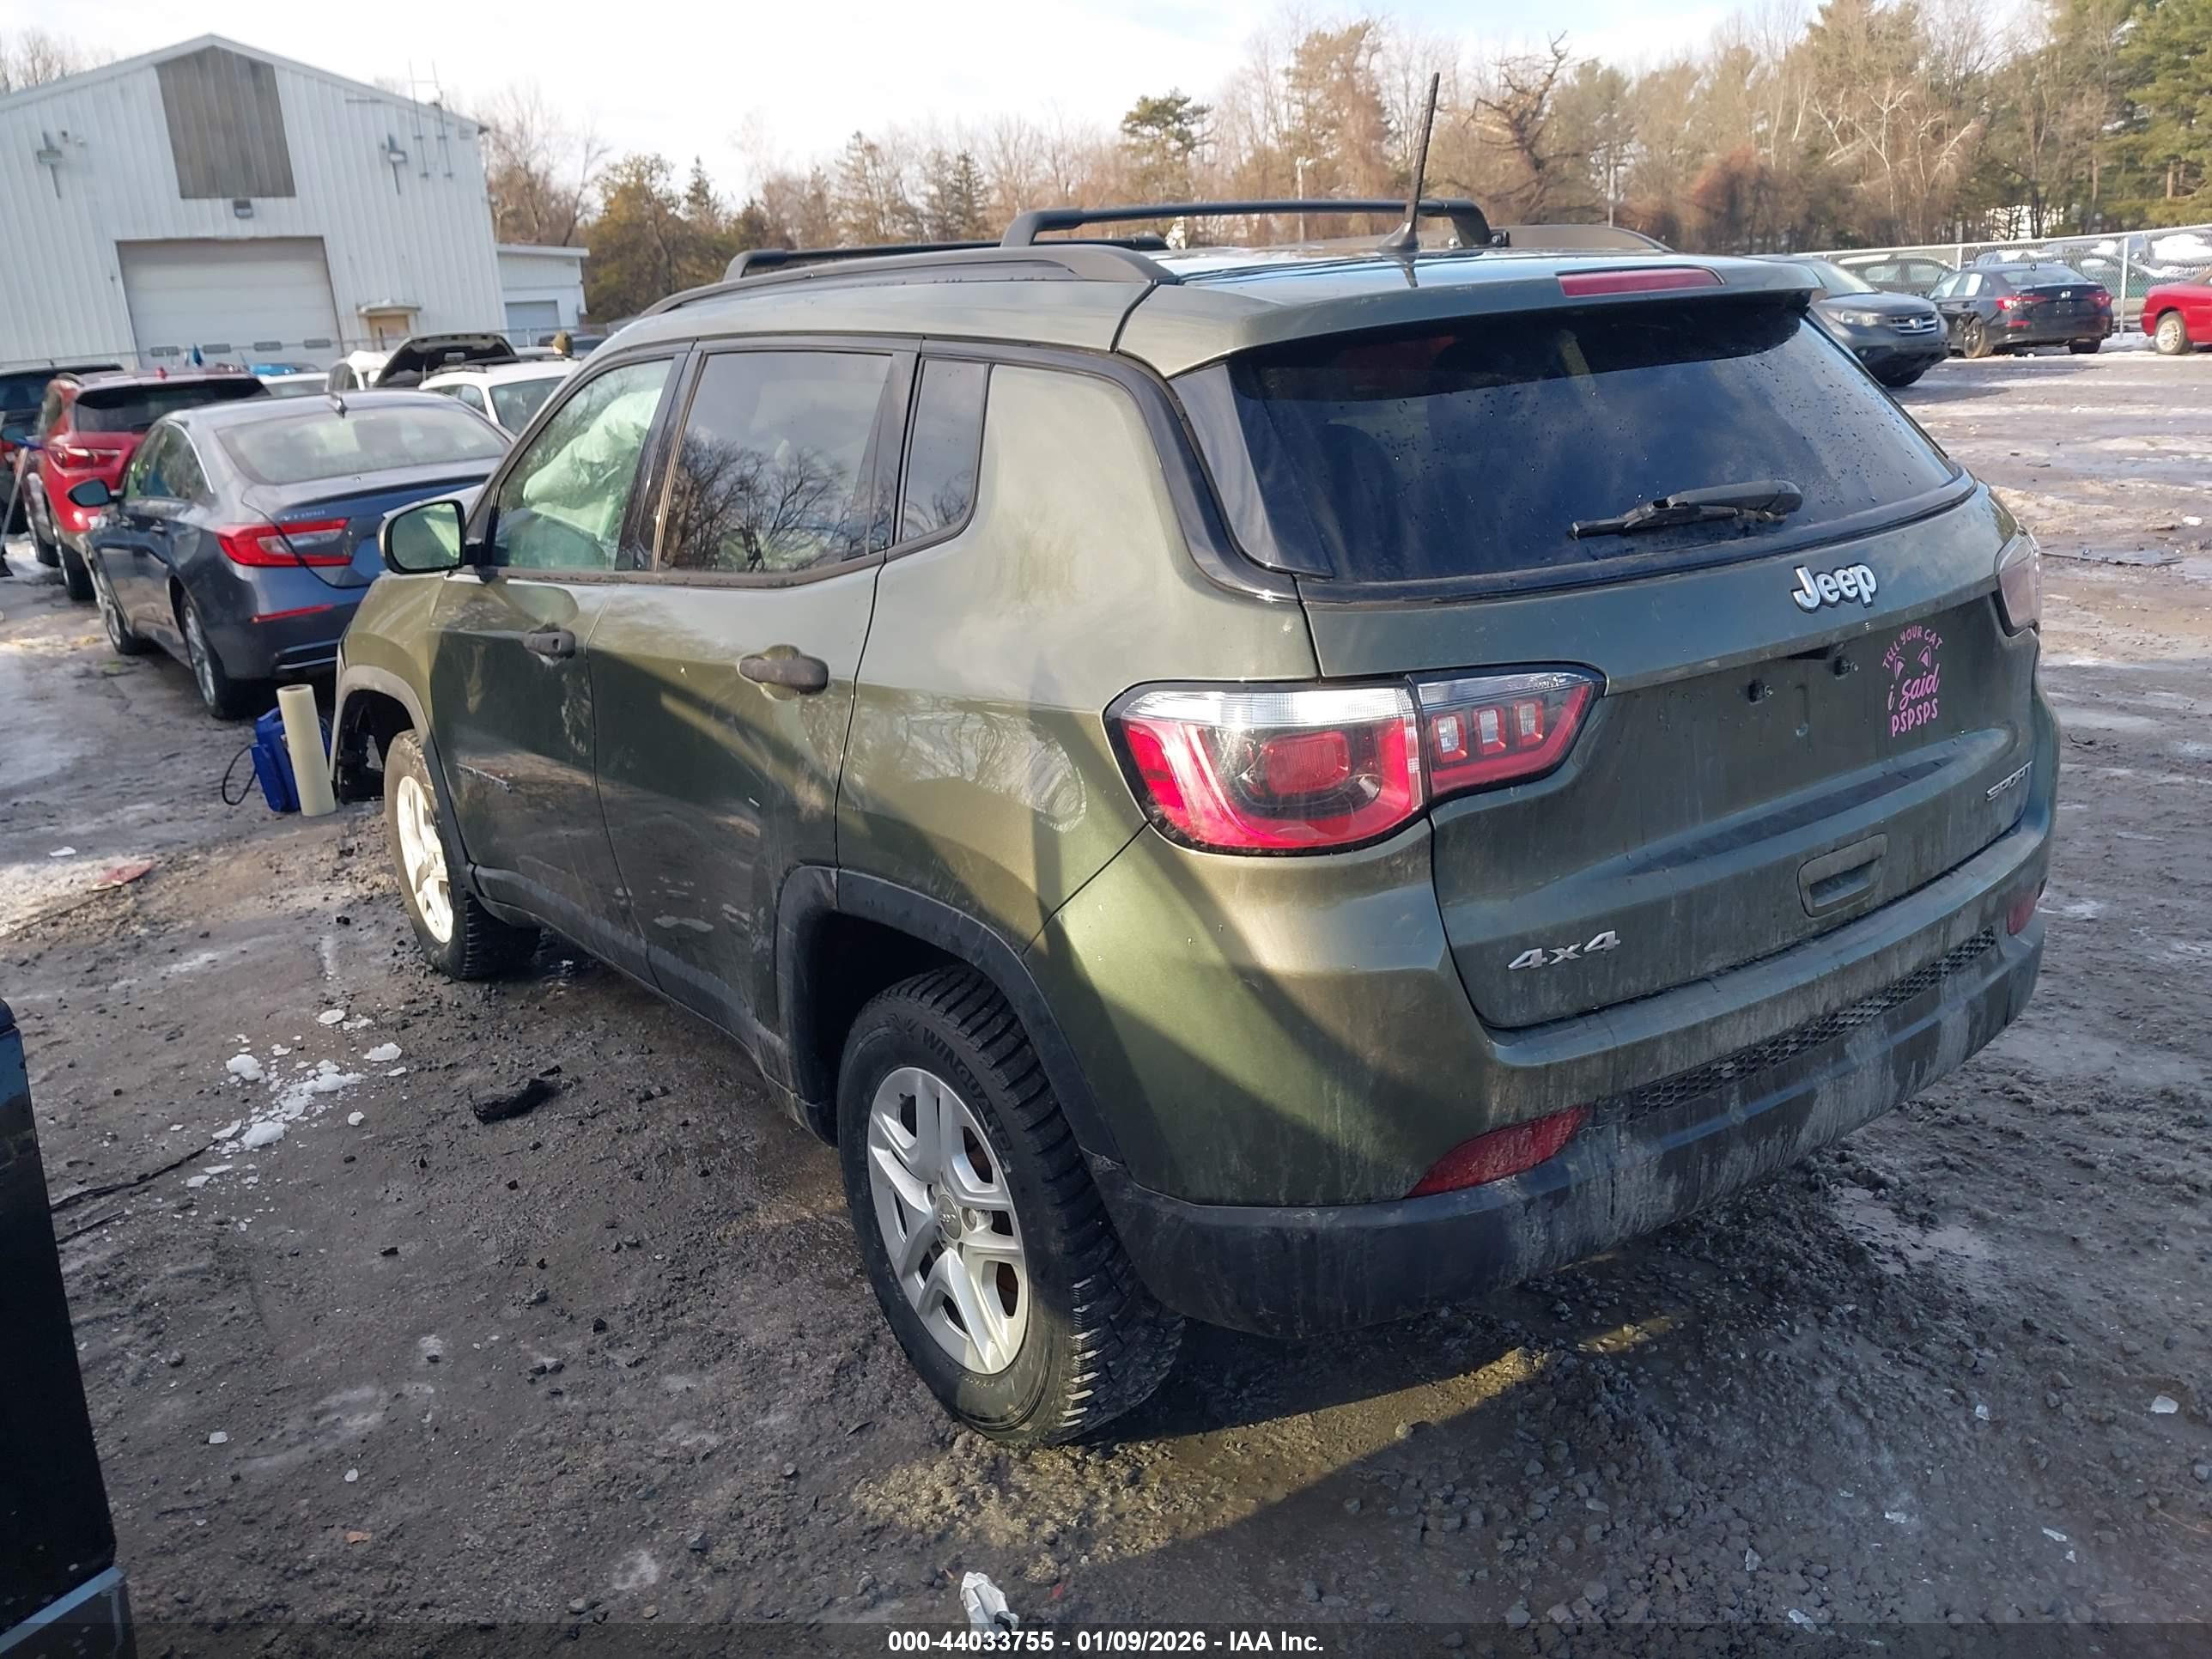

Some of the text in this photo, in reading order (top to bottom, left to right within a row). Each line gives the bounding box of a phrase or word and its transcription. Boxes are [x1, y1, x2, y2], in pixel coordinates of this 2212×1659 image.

[1792, 563, 1878, 613] Jeep
[1882, 625, 1943, 669] TELL YOUR CAT
[1899, 663, 1940, 711] said
[1892, 697, 1938, 738] PSPSPS
[1985, 761, 2033, 801] SPORT
[1508, 930, 1621, 970] 4x4
